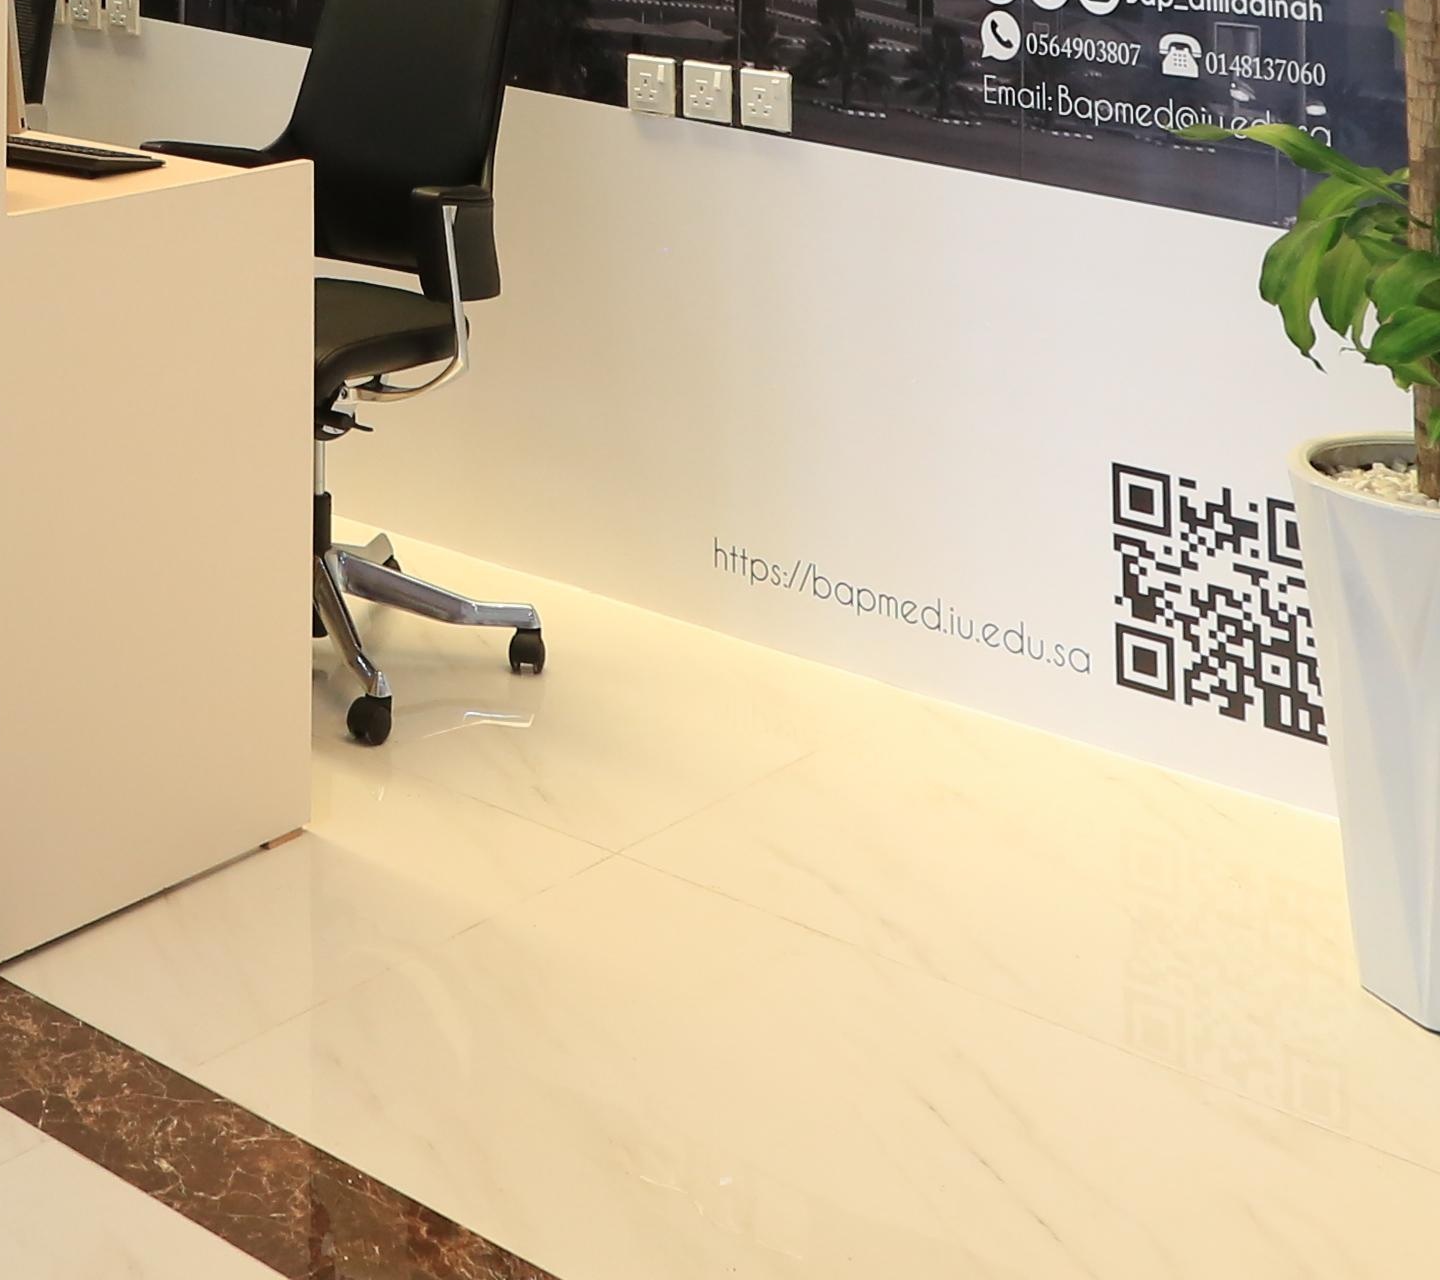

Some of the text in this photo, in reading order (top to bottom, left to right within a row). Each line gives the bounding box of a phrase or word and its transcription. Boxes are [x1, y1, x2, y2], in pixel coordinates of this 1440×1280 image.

[1025, 32, 1327, 87] 0564903807 0148137060
[983, 74, 1053, 113] Email:
[713, 536, 1092, 675] https://bapmed.iu.edu.sa
